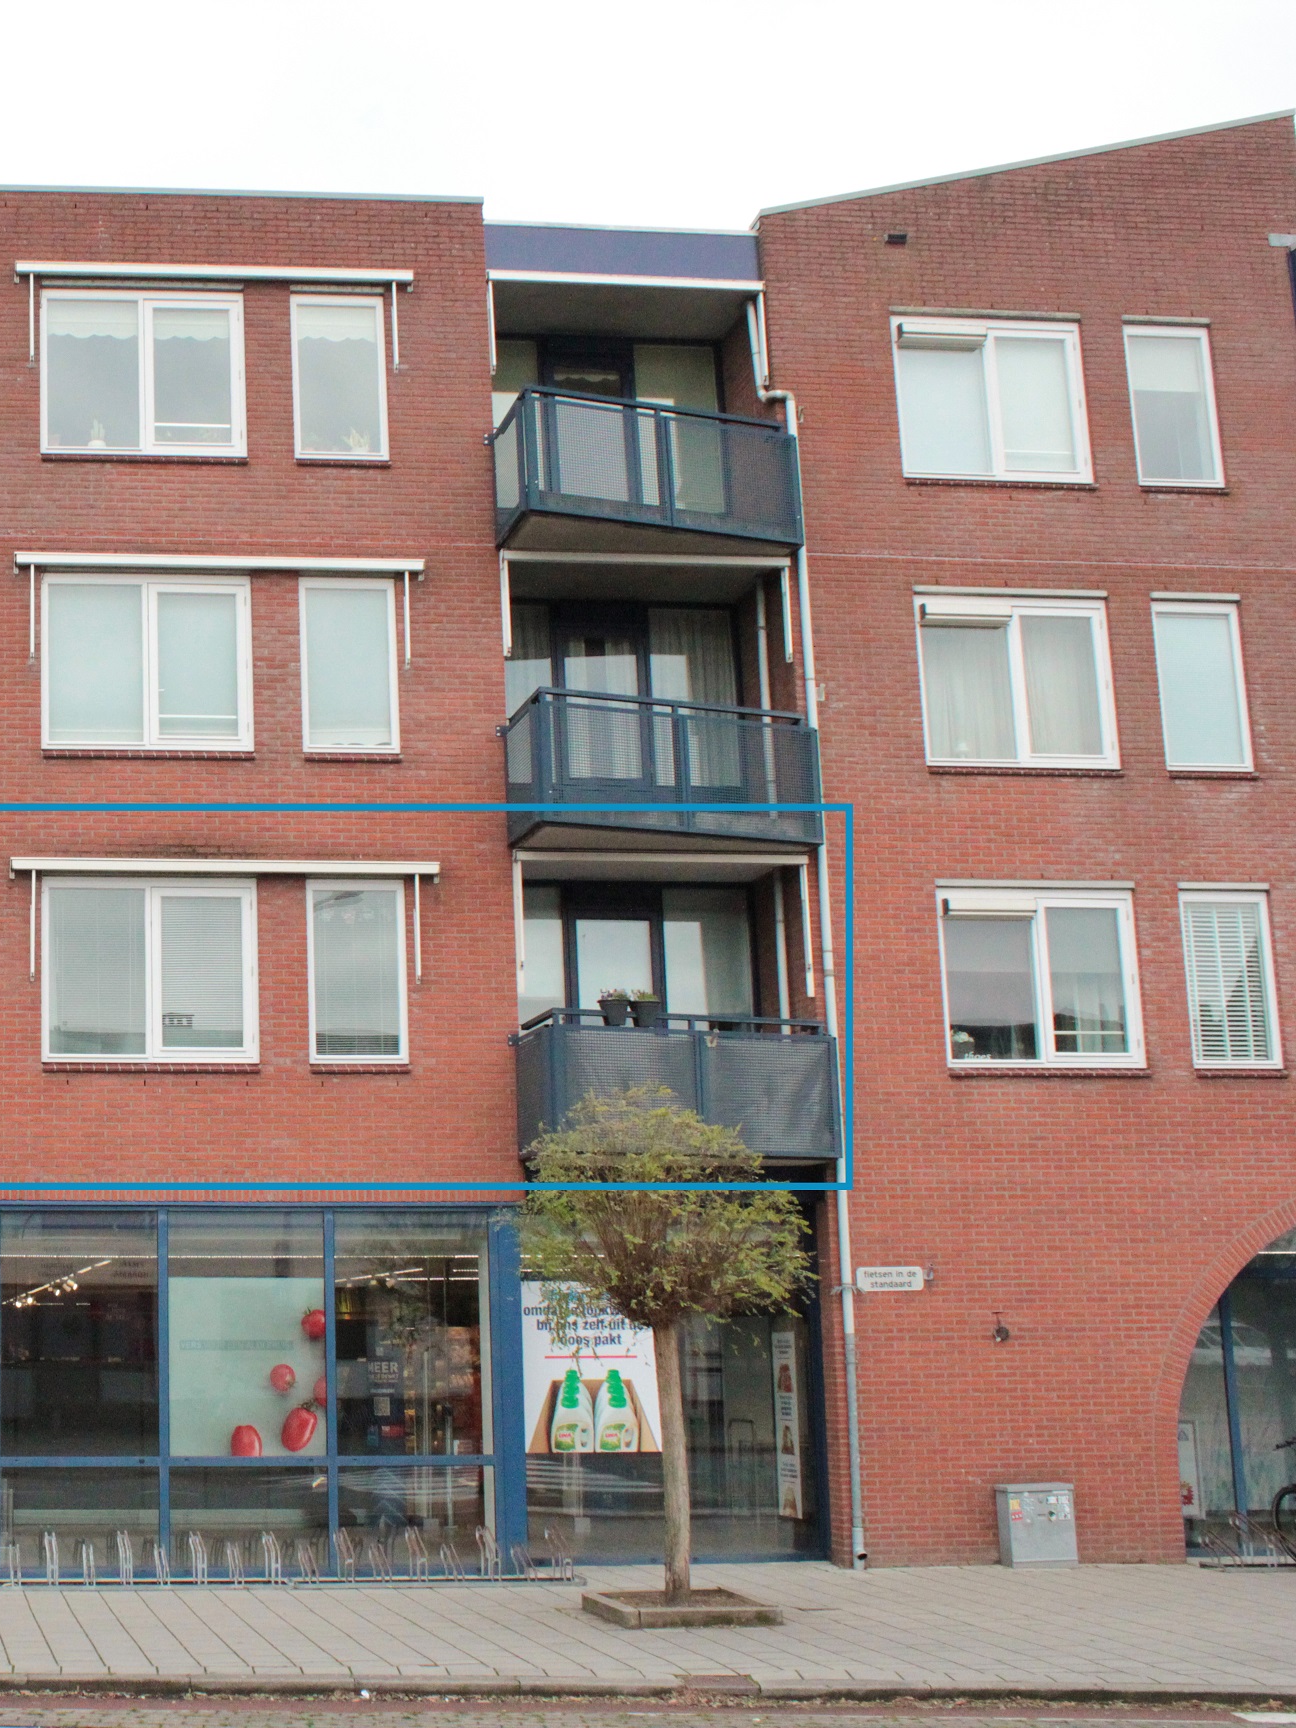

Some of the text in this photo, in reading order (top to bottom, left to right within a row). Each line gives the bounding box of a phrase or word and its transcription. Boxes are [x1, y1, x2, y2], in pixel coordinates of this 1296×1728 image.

[864, 1269, 917, 1278] fietsen in de
[870, 1280, 912, 1289] standaard
[582, 1318, 605, 1330] zelf
[593, 1333, 622, 1347] pakt
